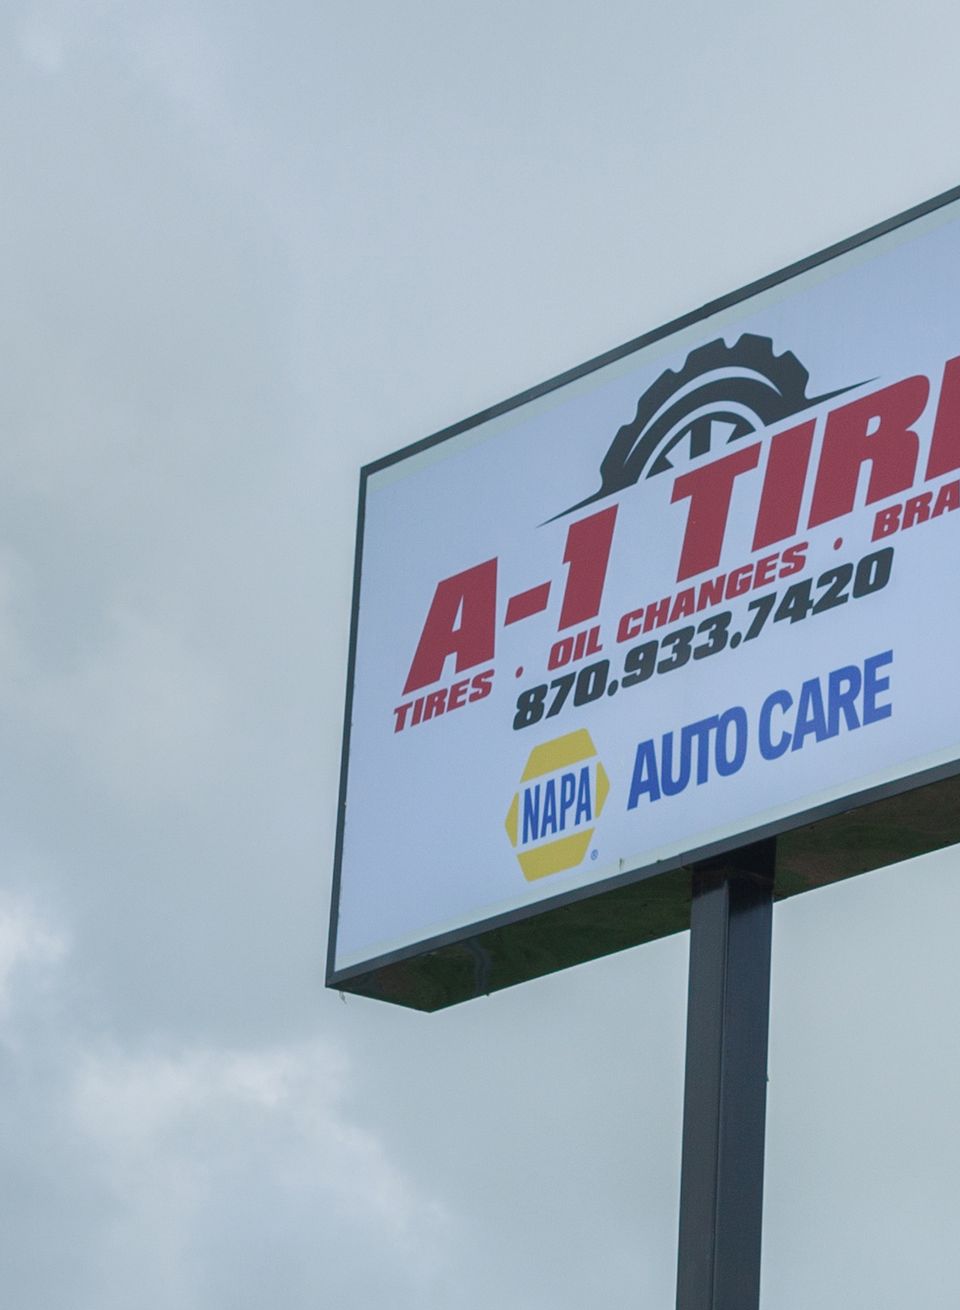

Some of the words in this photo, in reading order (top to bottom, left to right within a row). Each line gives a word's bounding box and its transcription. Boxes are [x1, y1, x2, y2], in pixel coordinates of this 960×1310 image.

[394, 670, 495, 733] TIRES
[548, 626, 602, 672] OIL
[616, 541, 809, 643] CHANGES
[403, 504, 618, 696] A-1
[512, 547, 894, 731] 870.933.7420
[521, 766, 592, 845] NAPA
[626, 704, 748, 811] AUTO
[758, 649, 894, 762] CARE
